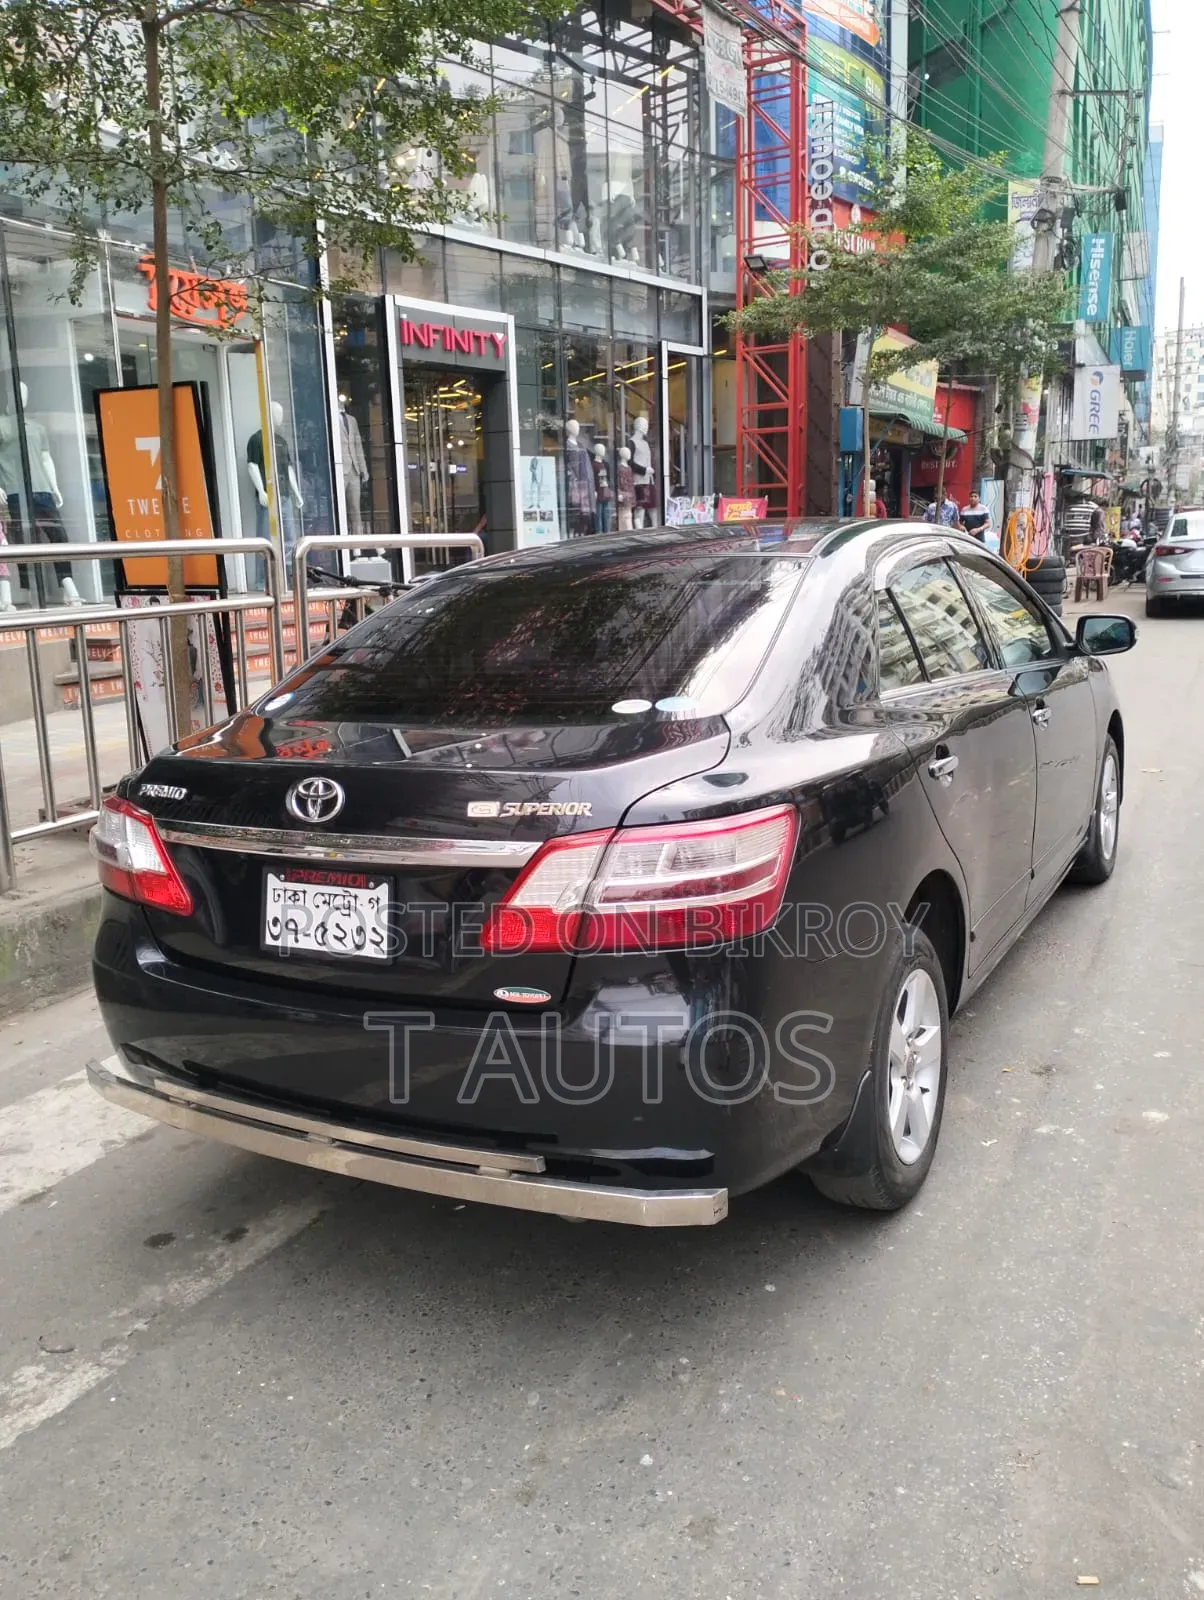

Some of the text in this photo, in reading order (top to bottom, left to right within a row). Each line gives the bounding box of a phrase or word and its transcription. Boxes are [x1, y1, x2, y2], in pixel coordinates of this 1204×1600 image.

[1086, 238, 1105, 316] Hisense
[400, 318, 508, 358] INFINITY
[1123, 330, 1137, 367] Haier
[1089, 388, 1102, 435] GREE
[127, 497, 191, 516] TWEE
[125, 529, 203, 539] CLOTNG
[139, 784, 188, 800] PREMIO
[499, 802, 592, 817] SUPERIOR
[273, 887, 306, 908] ঢাকা
[267, 916, 385, 954] ৩৭-৫২৩২
